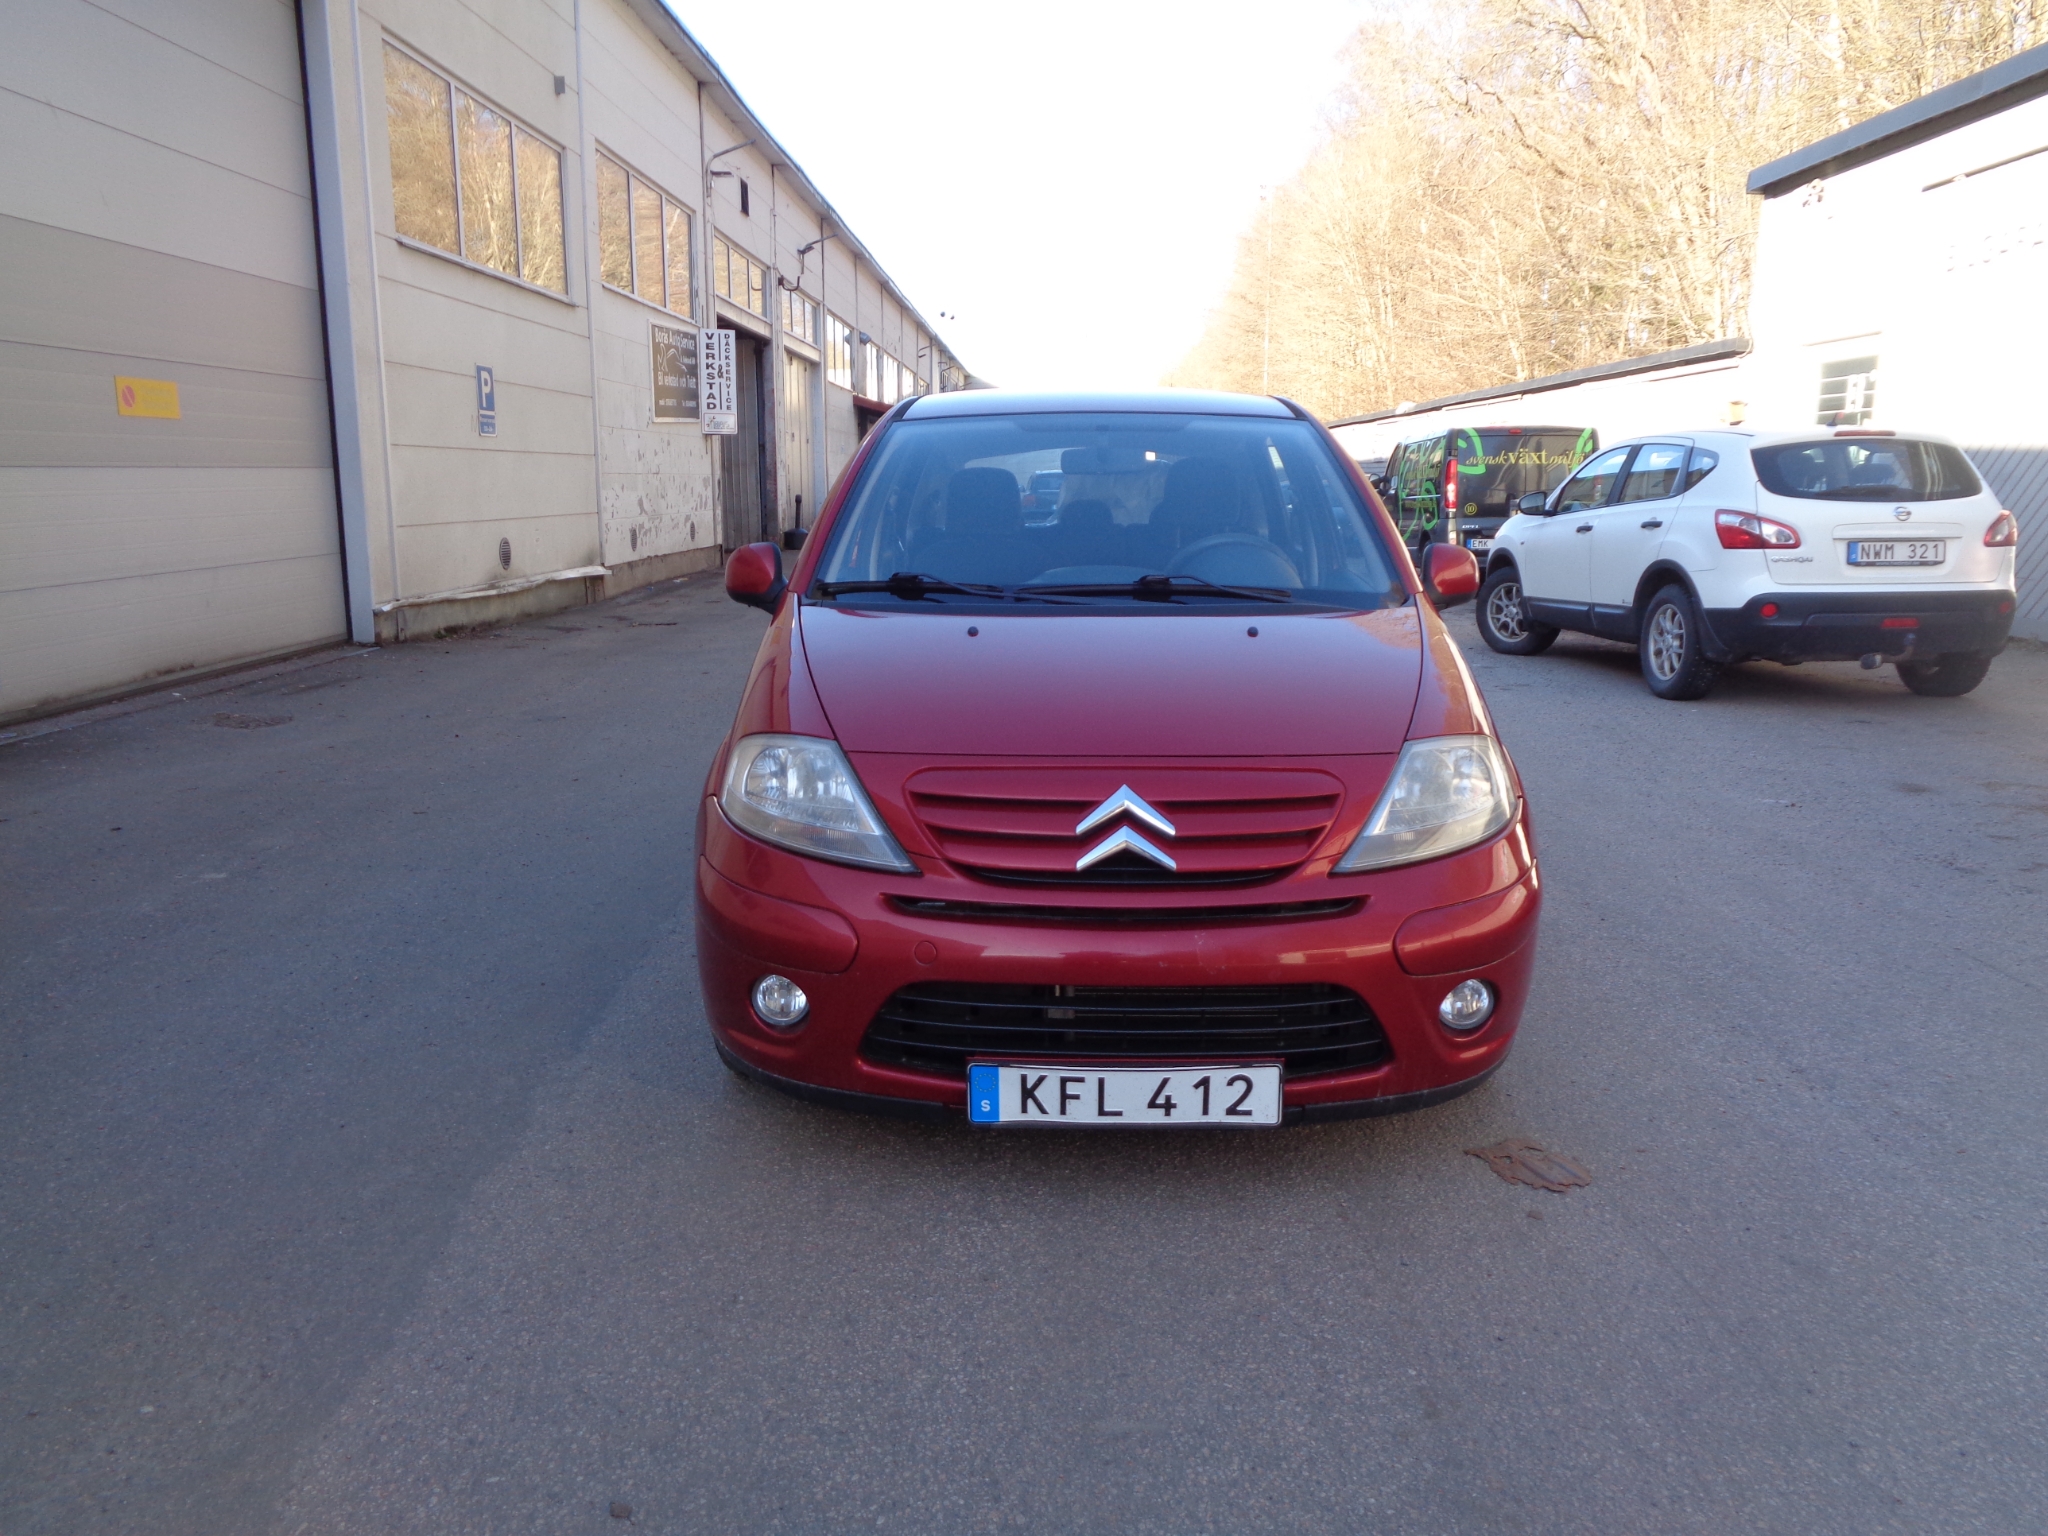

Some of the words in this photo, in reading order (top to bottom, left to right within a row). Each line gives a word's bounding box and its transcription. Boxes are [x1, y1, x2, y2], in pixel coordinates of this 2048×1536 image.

[705, 332, 717, 410] VERKSTAD
[717, 364, 724, 379] &
[724, 333, 732, 411] DÄCKSERVICE
[480, 370, 491, 408] P
[1472, 540, 1489, 548] EMK
[1860, 543, 1895, 560] NWM
[1907, 543, 1940, 560] 321
[980, 1099, 991, 1112] S
[1019, 1072, 1124, 1118] KFL
[1146, 1072, 1254, 1118] 412
